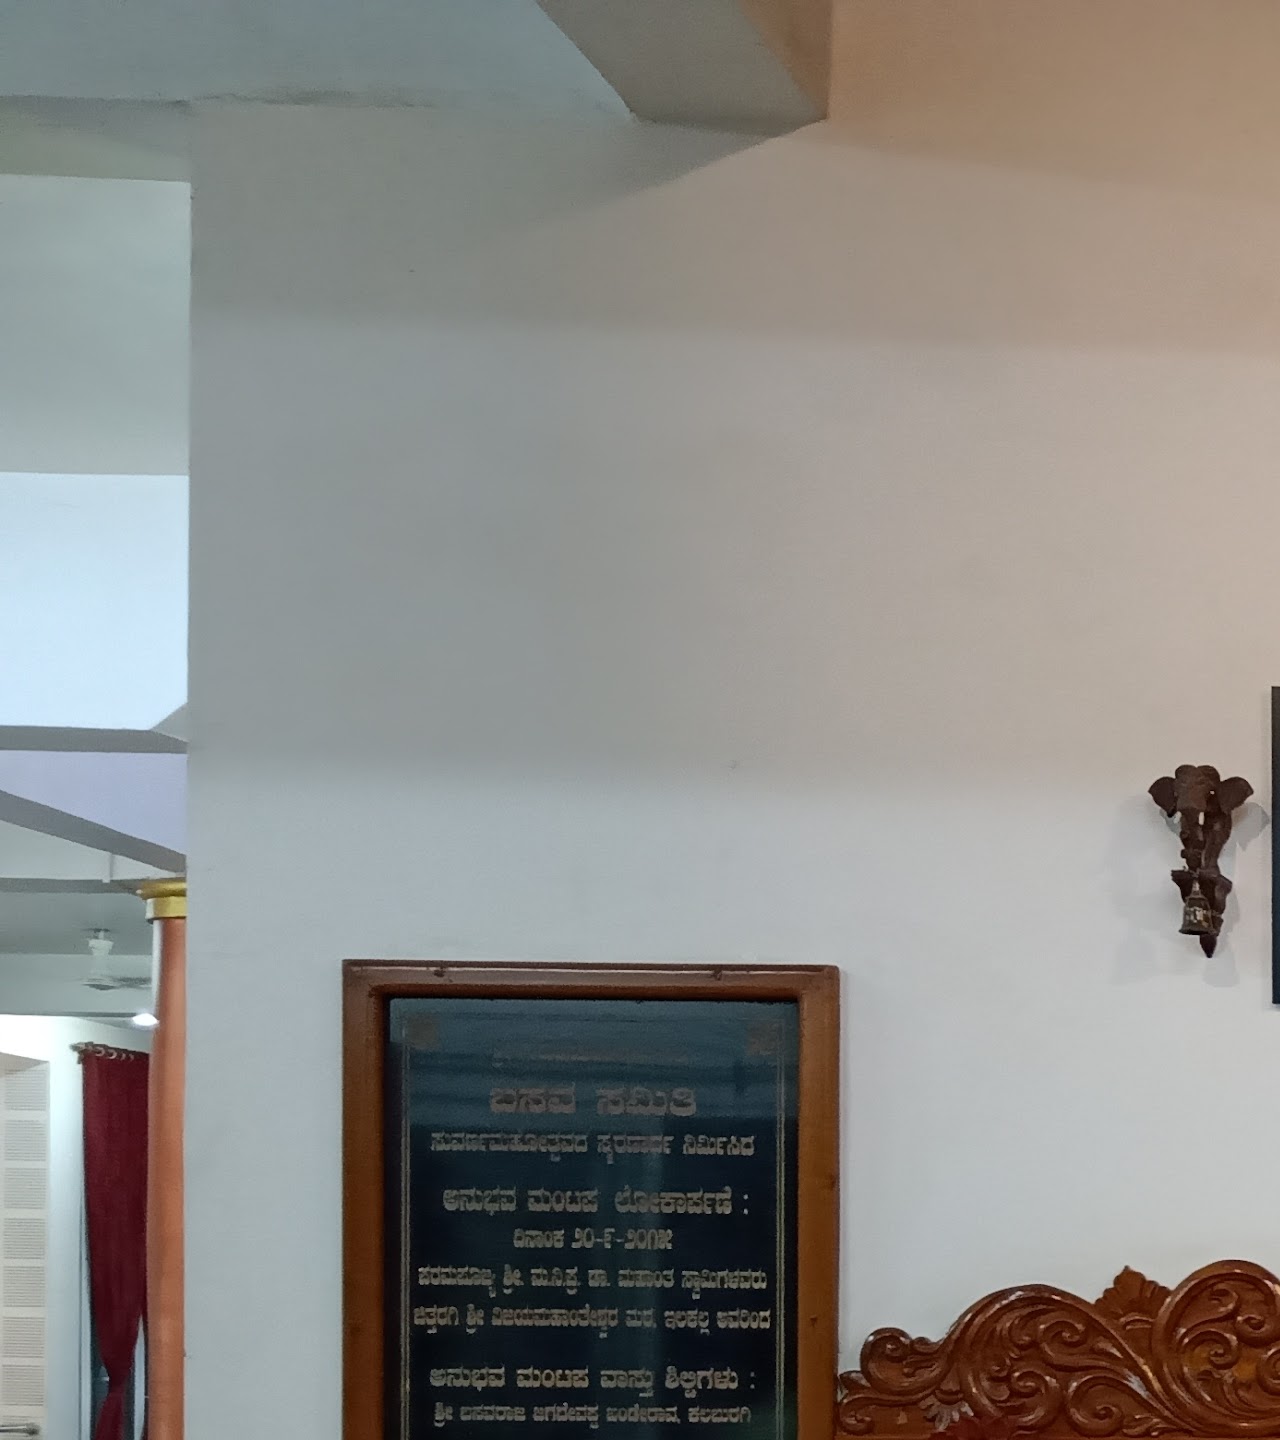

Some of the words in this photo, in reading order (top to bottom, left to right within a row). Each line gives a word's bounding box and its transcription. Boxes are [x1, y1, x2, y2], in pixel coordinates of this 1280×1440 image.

[443, 1187, 516, 1216] ಅನುಭವ
[528, 1188, 601, 1212] ಮಂಟಪ
[430, 1367, 505, 1391] ಅನುಭವ
[516, 1367, 589, 1387] ಮಂಟಪ
